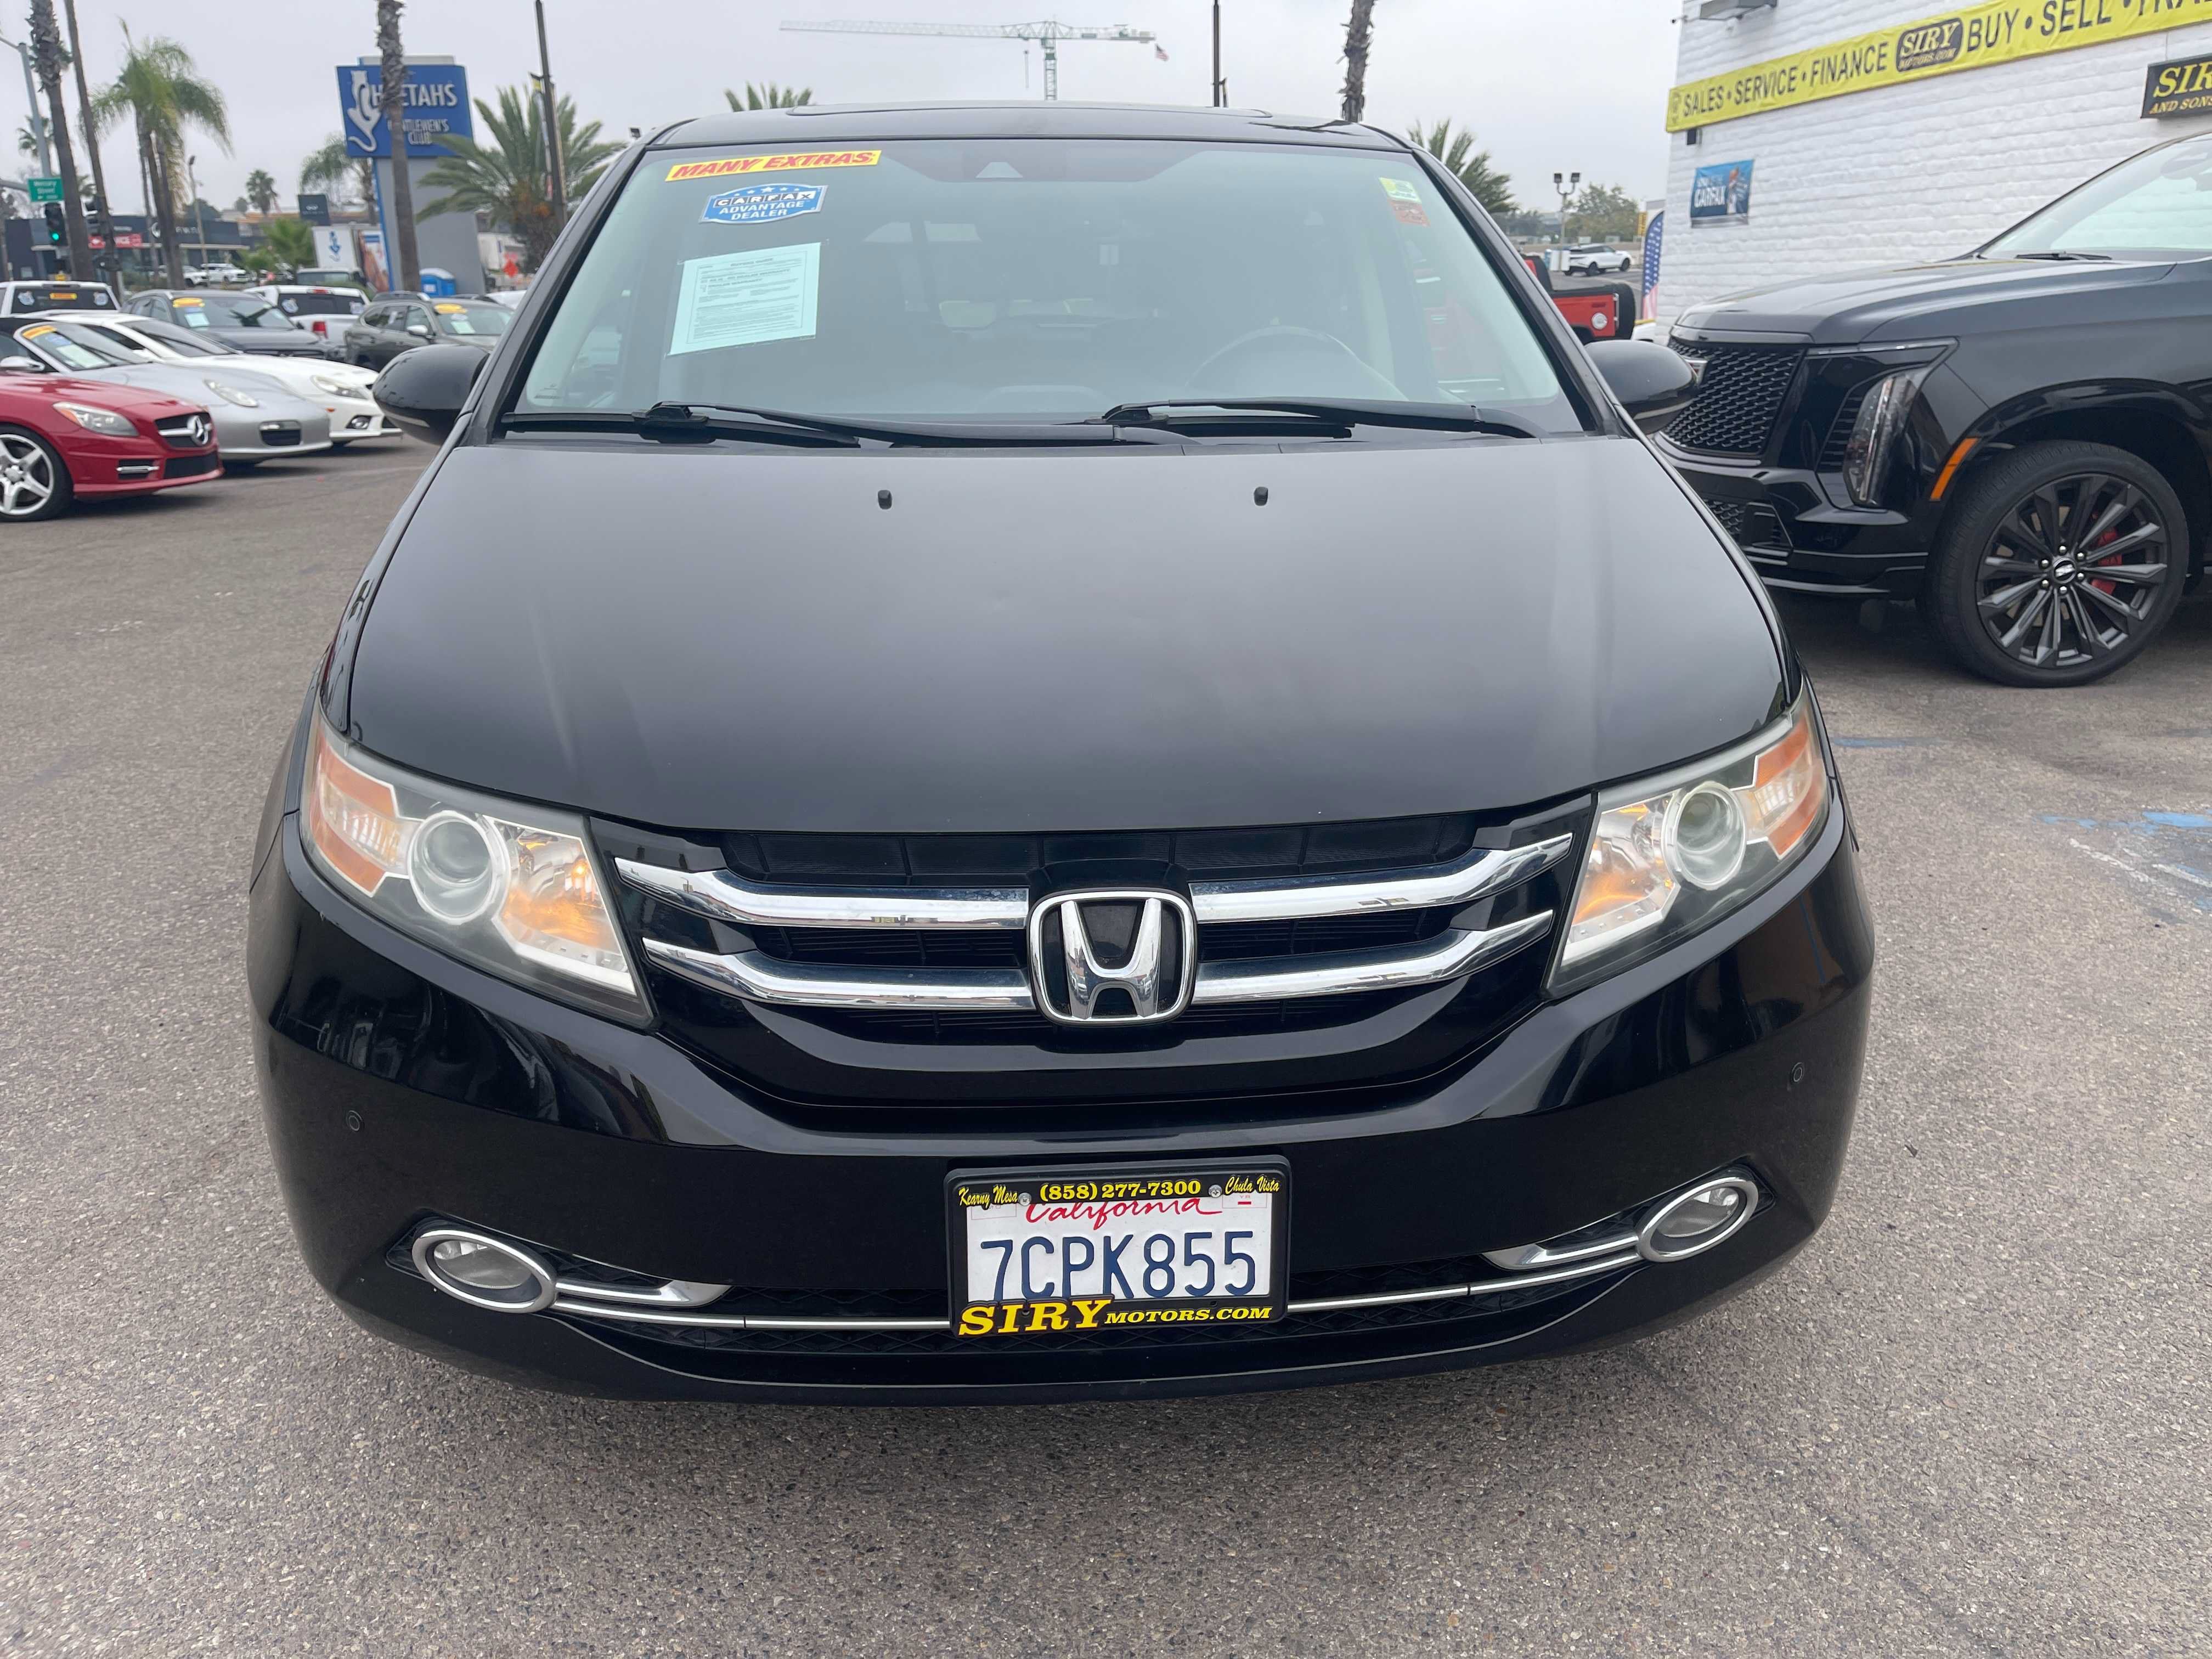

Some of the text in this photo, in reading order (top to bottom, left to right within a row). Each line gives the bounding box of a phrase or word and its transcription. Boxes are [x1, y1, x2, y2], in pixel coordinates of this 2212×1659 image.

[1967, 0, 2112, 53] BUY SELL
[1900, 22, 1959, 57] SIRY
[1684, 41, 1889, 117] SALES SERVICE FINANCE
[2148, 100, 2179, 114] AND
[672, 152, 873, 178] MANY EXTRAS
[715, 191, 814, 207] CARFAX
[719, 200, 804, 215] ADVANTAGE
[731, 208, 788, 220] DEALER
[958, 1185, 1018, 1207] Kearny Mesa
[1040, 1180, 1201, 1202] (858) 277-7300
[1225, 1175, 1280, 1195] Chula Vista
[1026, 1198, 1223, 1231] California
[980, 1231, 1255, 1300] 7CPK855
[958, 1299, 1274, 1336] SIRY MOTORS.COM
